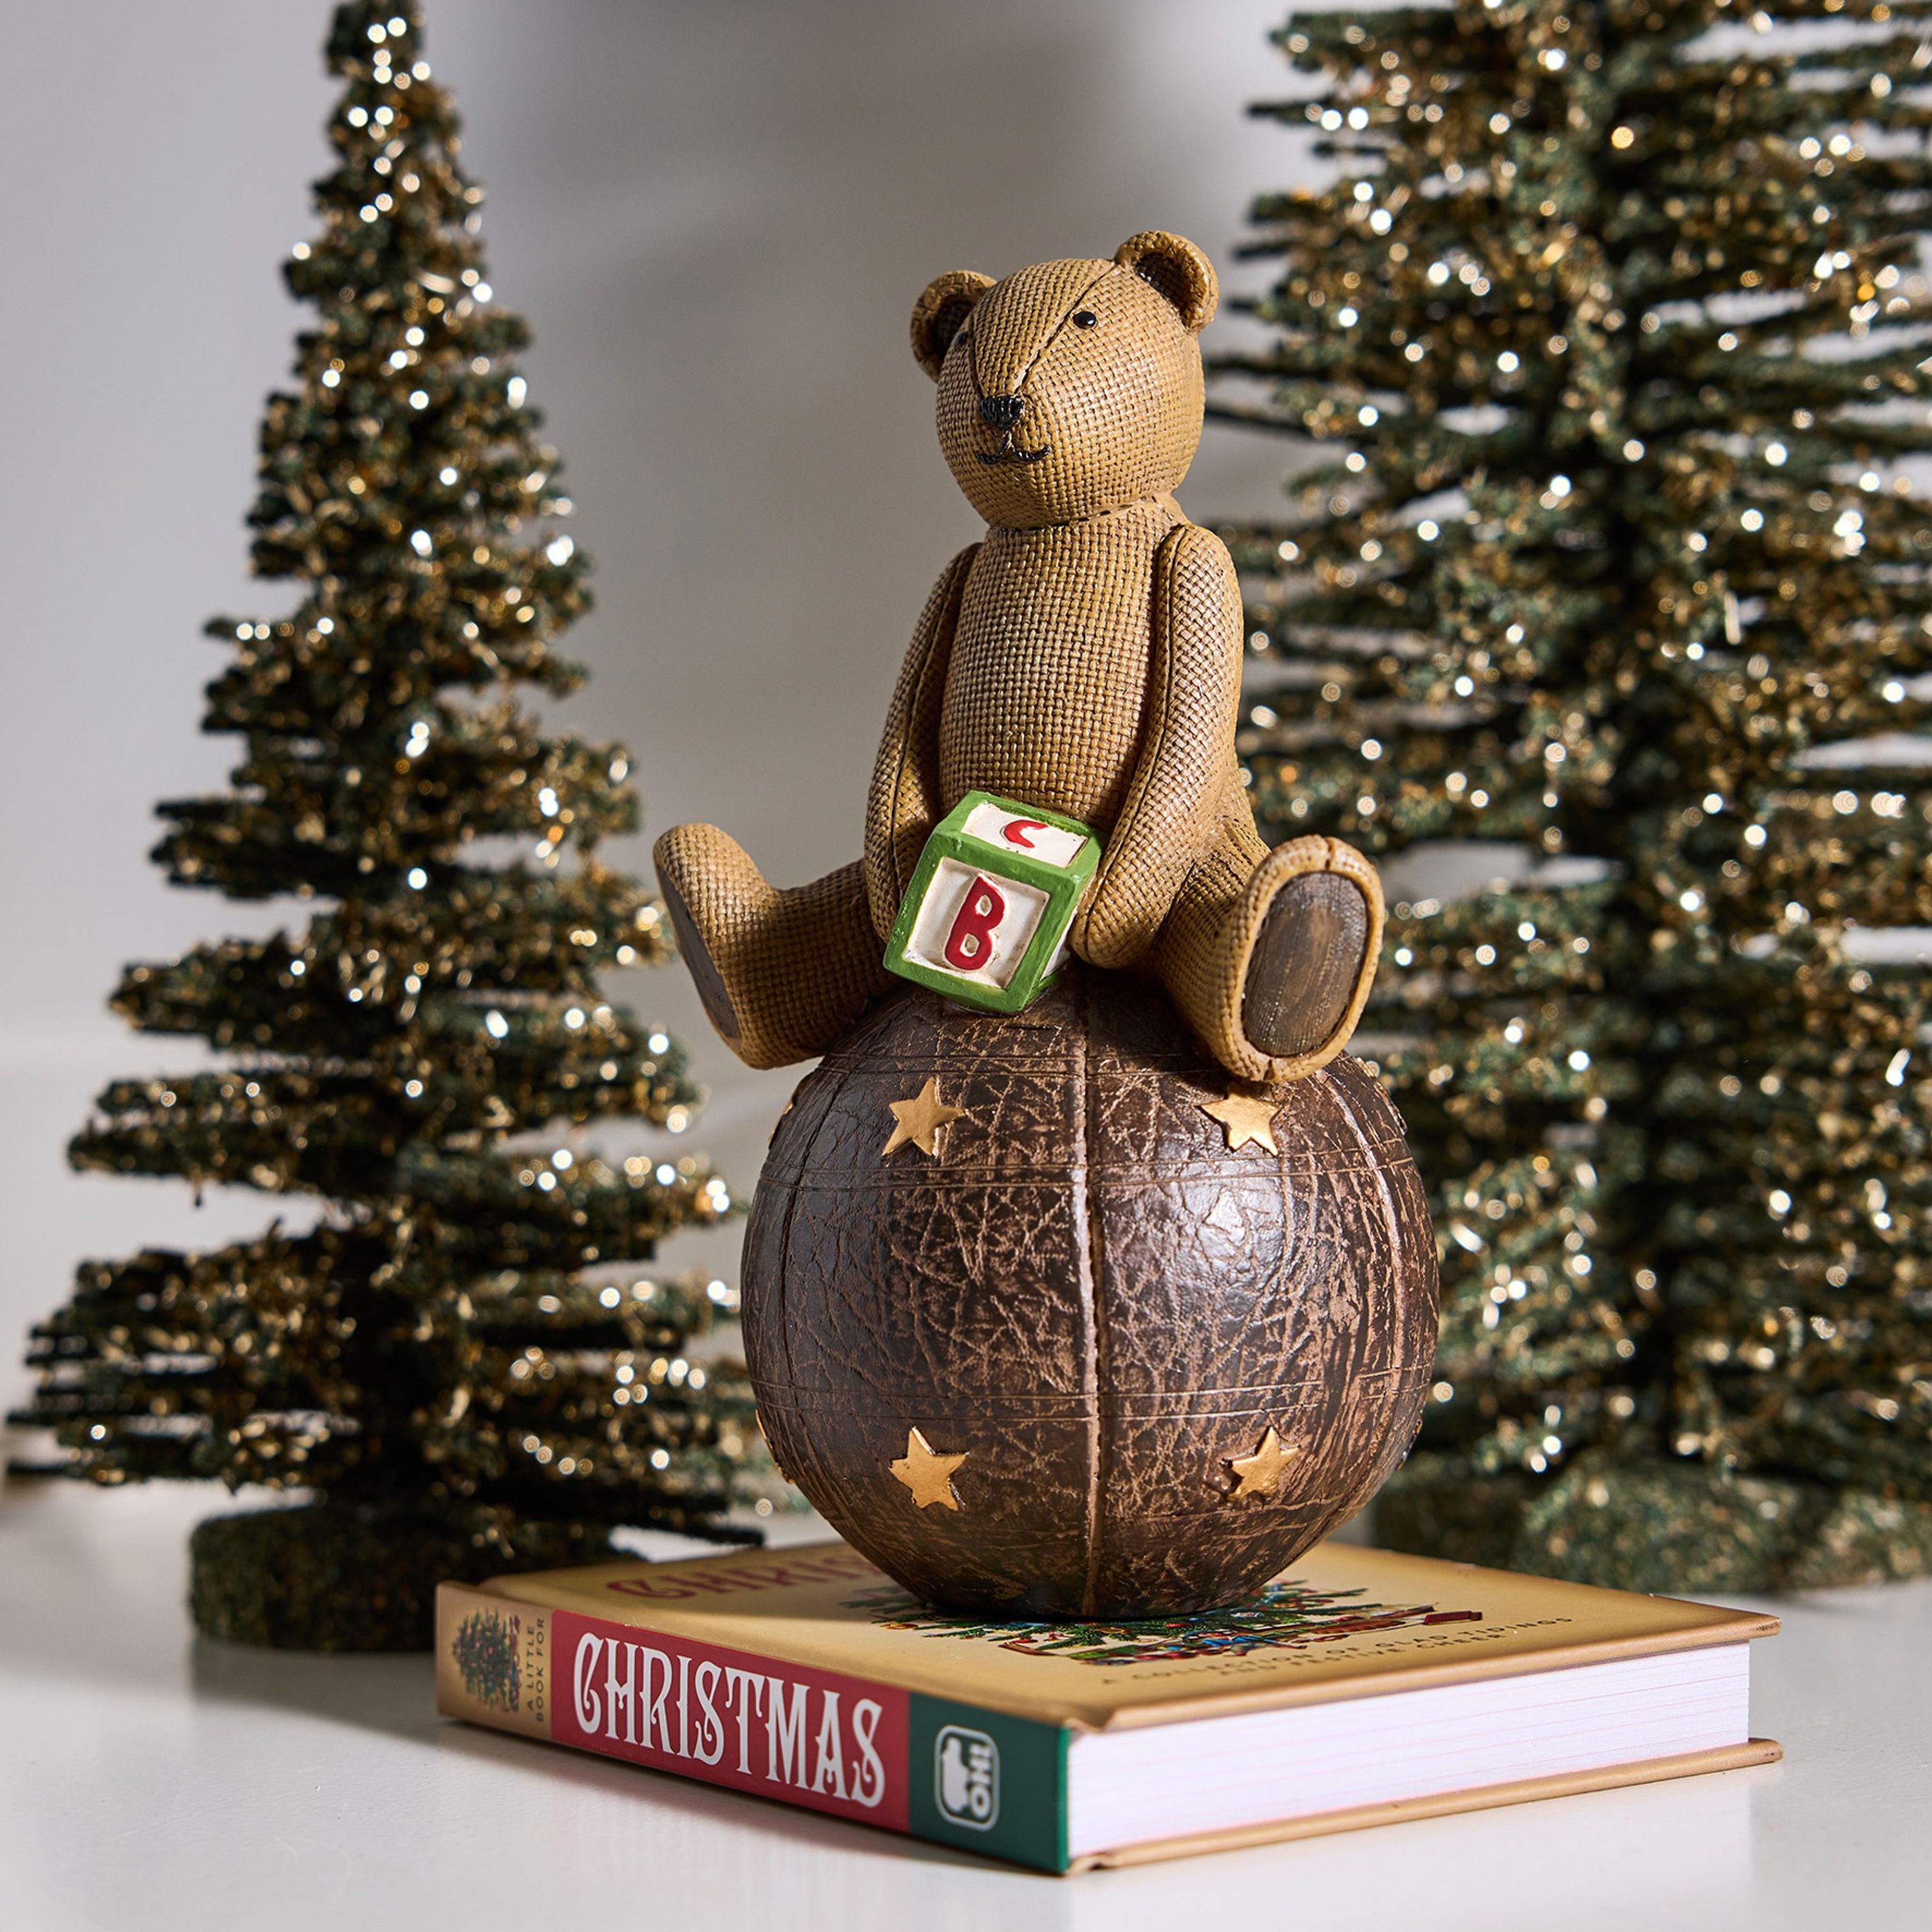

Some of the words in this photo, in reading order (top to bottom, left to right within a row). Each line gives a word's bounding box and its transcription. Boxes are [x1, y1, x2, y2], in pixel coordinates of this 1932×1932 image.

[1003, 819, 1050, 849] C
[944, 875, 1005, 971] B
[526, 1626, 535, 1689] LITTLE
[536, 1618, 545, 1656] FOR
[1132, 1653, 1313, 1679] COLLECTION
[1375, 1634, 1448, 1647] GLAD
[1457, 1617, 1573, 1636] TIDINGS
[1290, 1647, 1406, 1666] FESTIVE
[1417, 1634, 1506, 1648] CHEER
[527, 1699, 535, 1710] A
[536, 1667, 544, 1721] BOOK
[573, 1632, 886, 1808] CHRISTMAS
